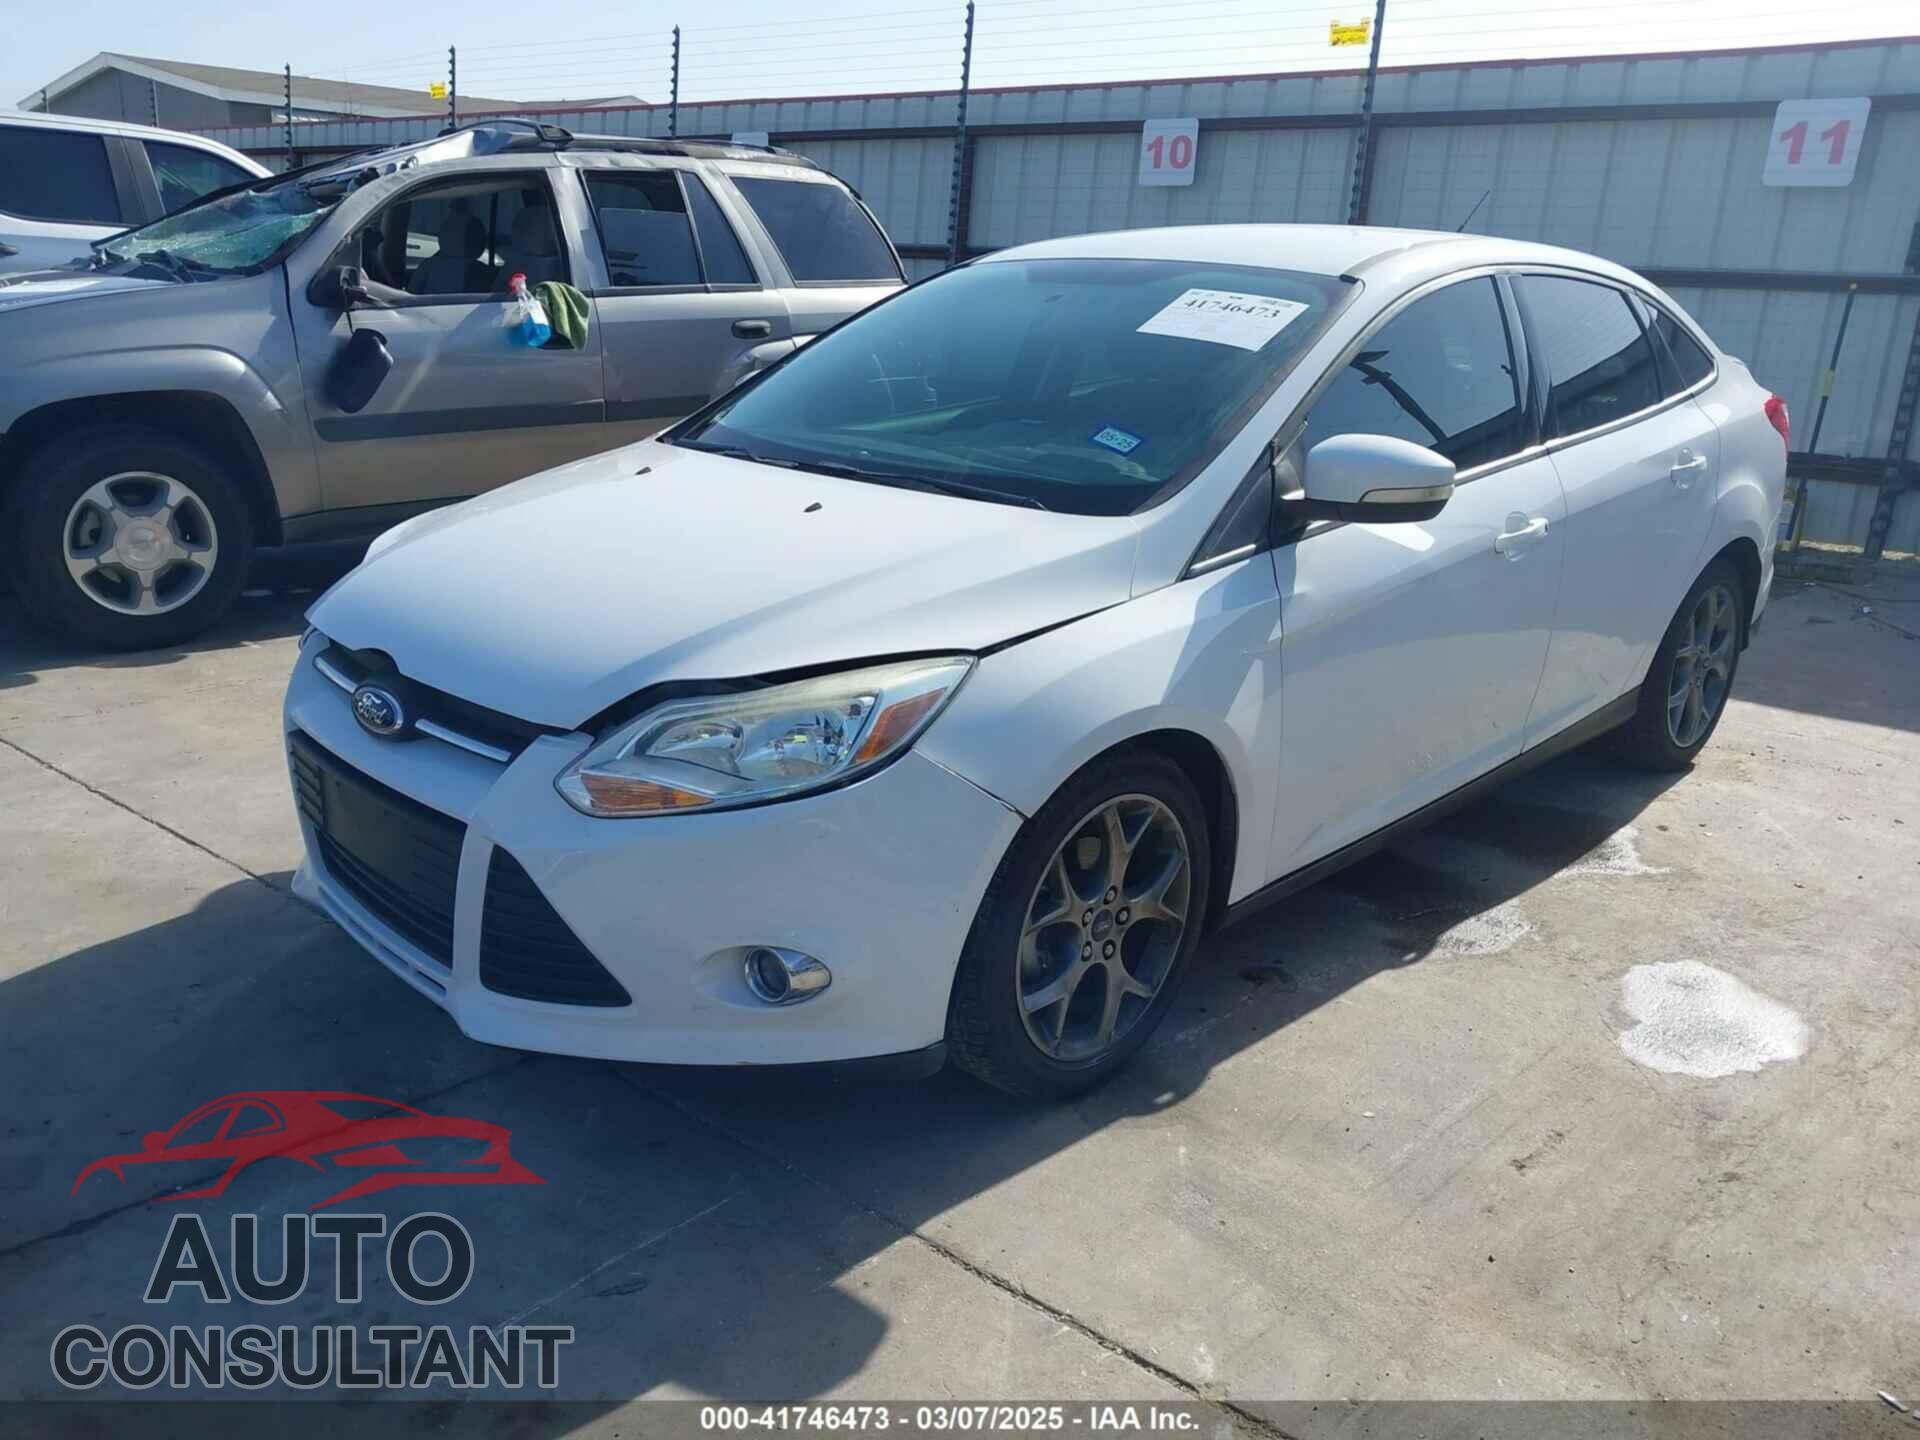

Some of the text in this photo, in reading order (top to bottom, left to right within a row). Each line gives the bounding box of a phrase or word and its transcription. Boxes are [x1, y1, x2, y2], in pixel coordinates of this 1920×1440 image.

[1146, 134, 1193, 169] 10
[1779, 119, 1851, 166] 11
[1184, 298, 1280, 319] 41746473
[357, 691, 388, 725] Ford
